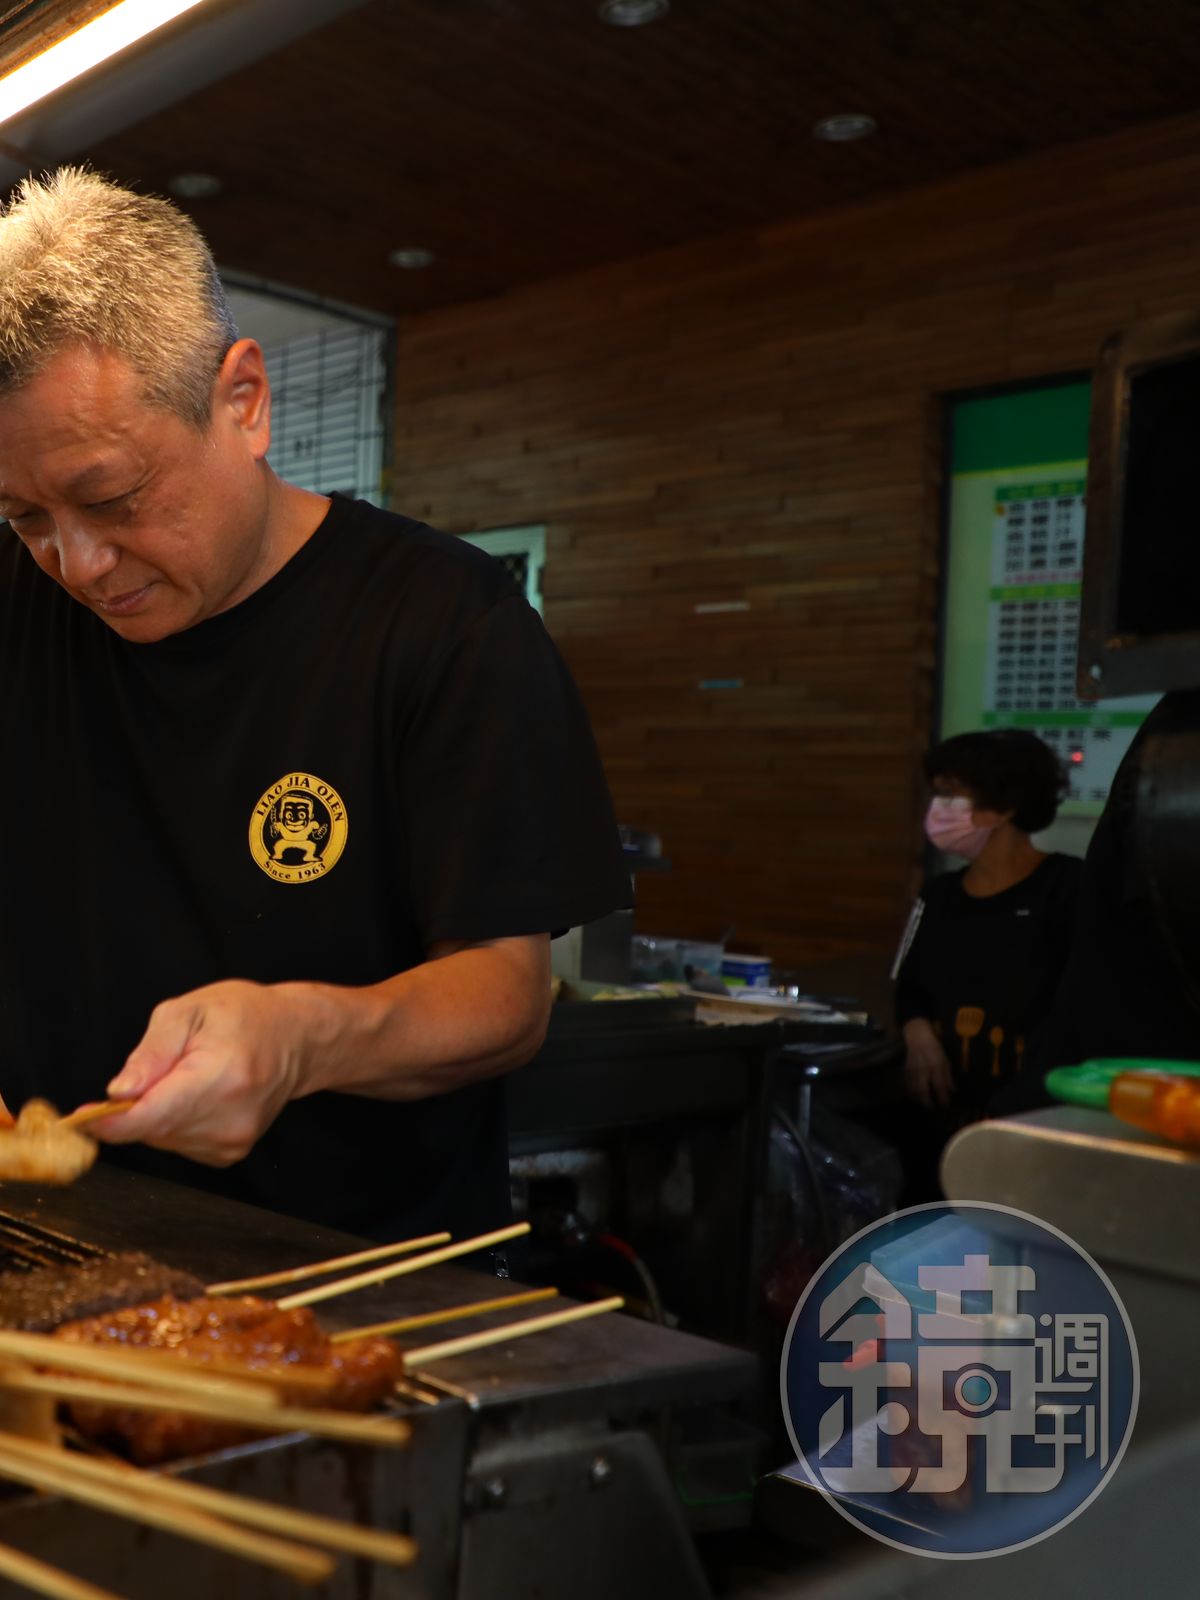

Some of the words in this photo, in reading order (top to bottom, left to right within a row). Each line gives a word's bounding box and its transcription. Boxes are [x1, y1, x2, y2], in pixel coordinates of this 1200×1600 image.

[257, 785, 283, 816] LIAO
[287, 776, 311, 788] JIA
[317, 785, 344, 822] OLEN
[264, 861, 291, 880] Since
[298, 862, 326, 879] 1963
